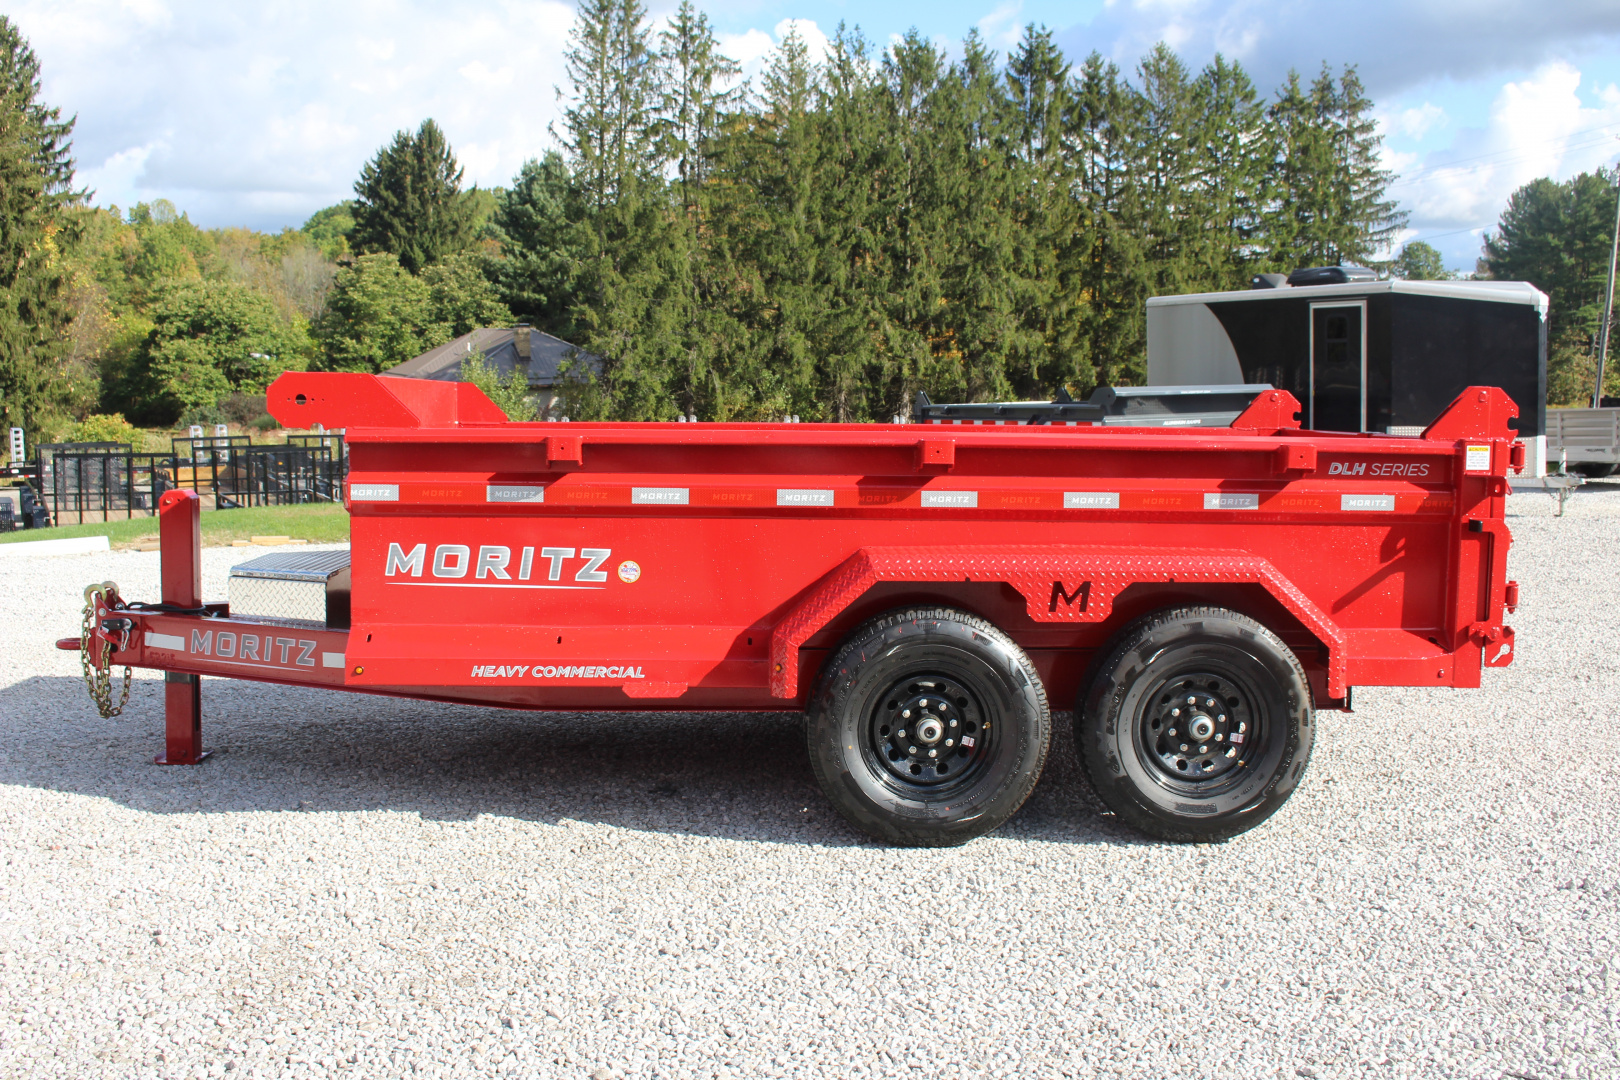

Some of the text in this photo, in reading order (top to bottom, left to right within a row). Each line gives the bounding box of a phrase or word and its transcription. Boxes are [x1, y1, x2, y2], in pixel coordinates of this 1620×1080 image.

[1328, 462, 1430, 476] DLH SERIES
[351, 489, 391, 497] MORITZ
[421, 489, 463, 497] MORITZ
[712, 493, 753, 501] MORITZ
[785, 494, 826, 502] MORITZ
[385, 542, 612, 583] MORITZ
[1048, 581, 1091, 613] M
[190, 629, 317, 667] MORITZ
[471, 665, 646, 678] HEAVY COMMERCIAL
